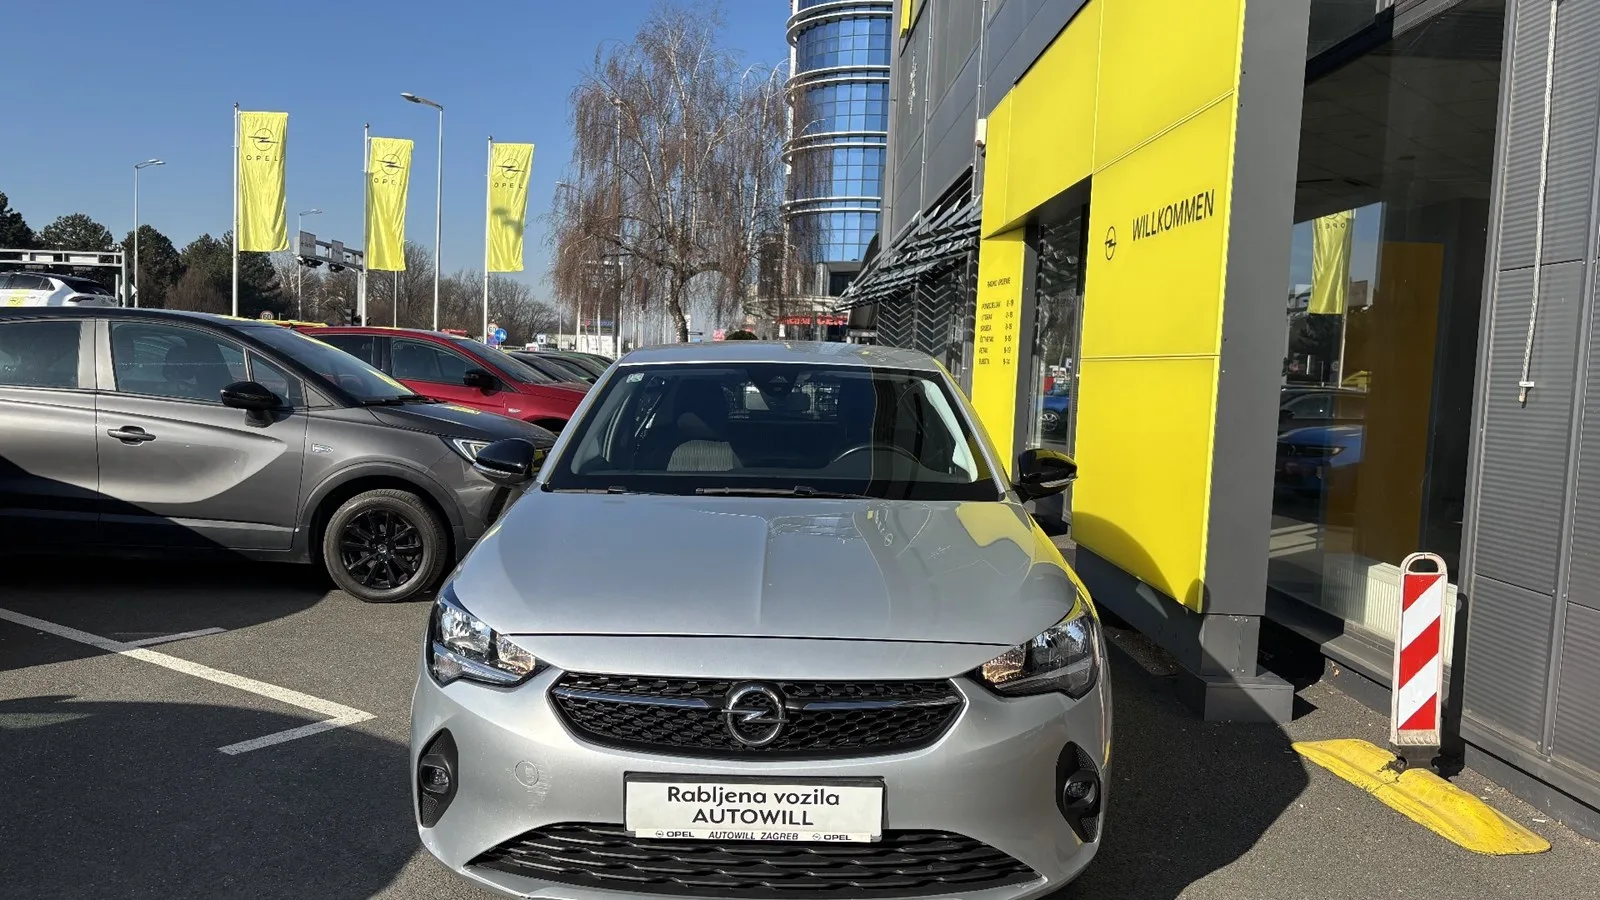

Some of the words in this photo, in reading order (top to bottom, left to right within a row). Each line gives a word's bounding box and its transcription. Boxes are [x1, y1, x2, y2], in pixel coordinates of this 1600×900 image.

[246, 154, 279, 162] OPEL
[1132, 188, 1214, 242] WILLKOMMEN
[667, 785, 767, 807] Rabljena
[774, 788, 840, 806] vozila
[692, 808, 814, 826] AUTOWILL
[708, 831, 756, 840] AUTOWILL
[760, 832, 799, 840] ZAGREB
